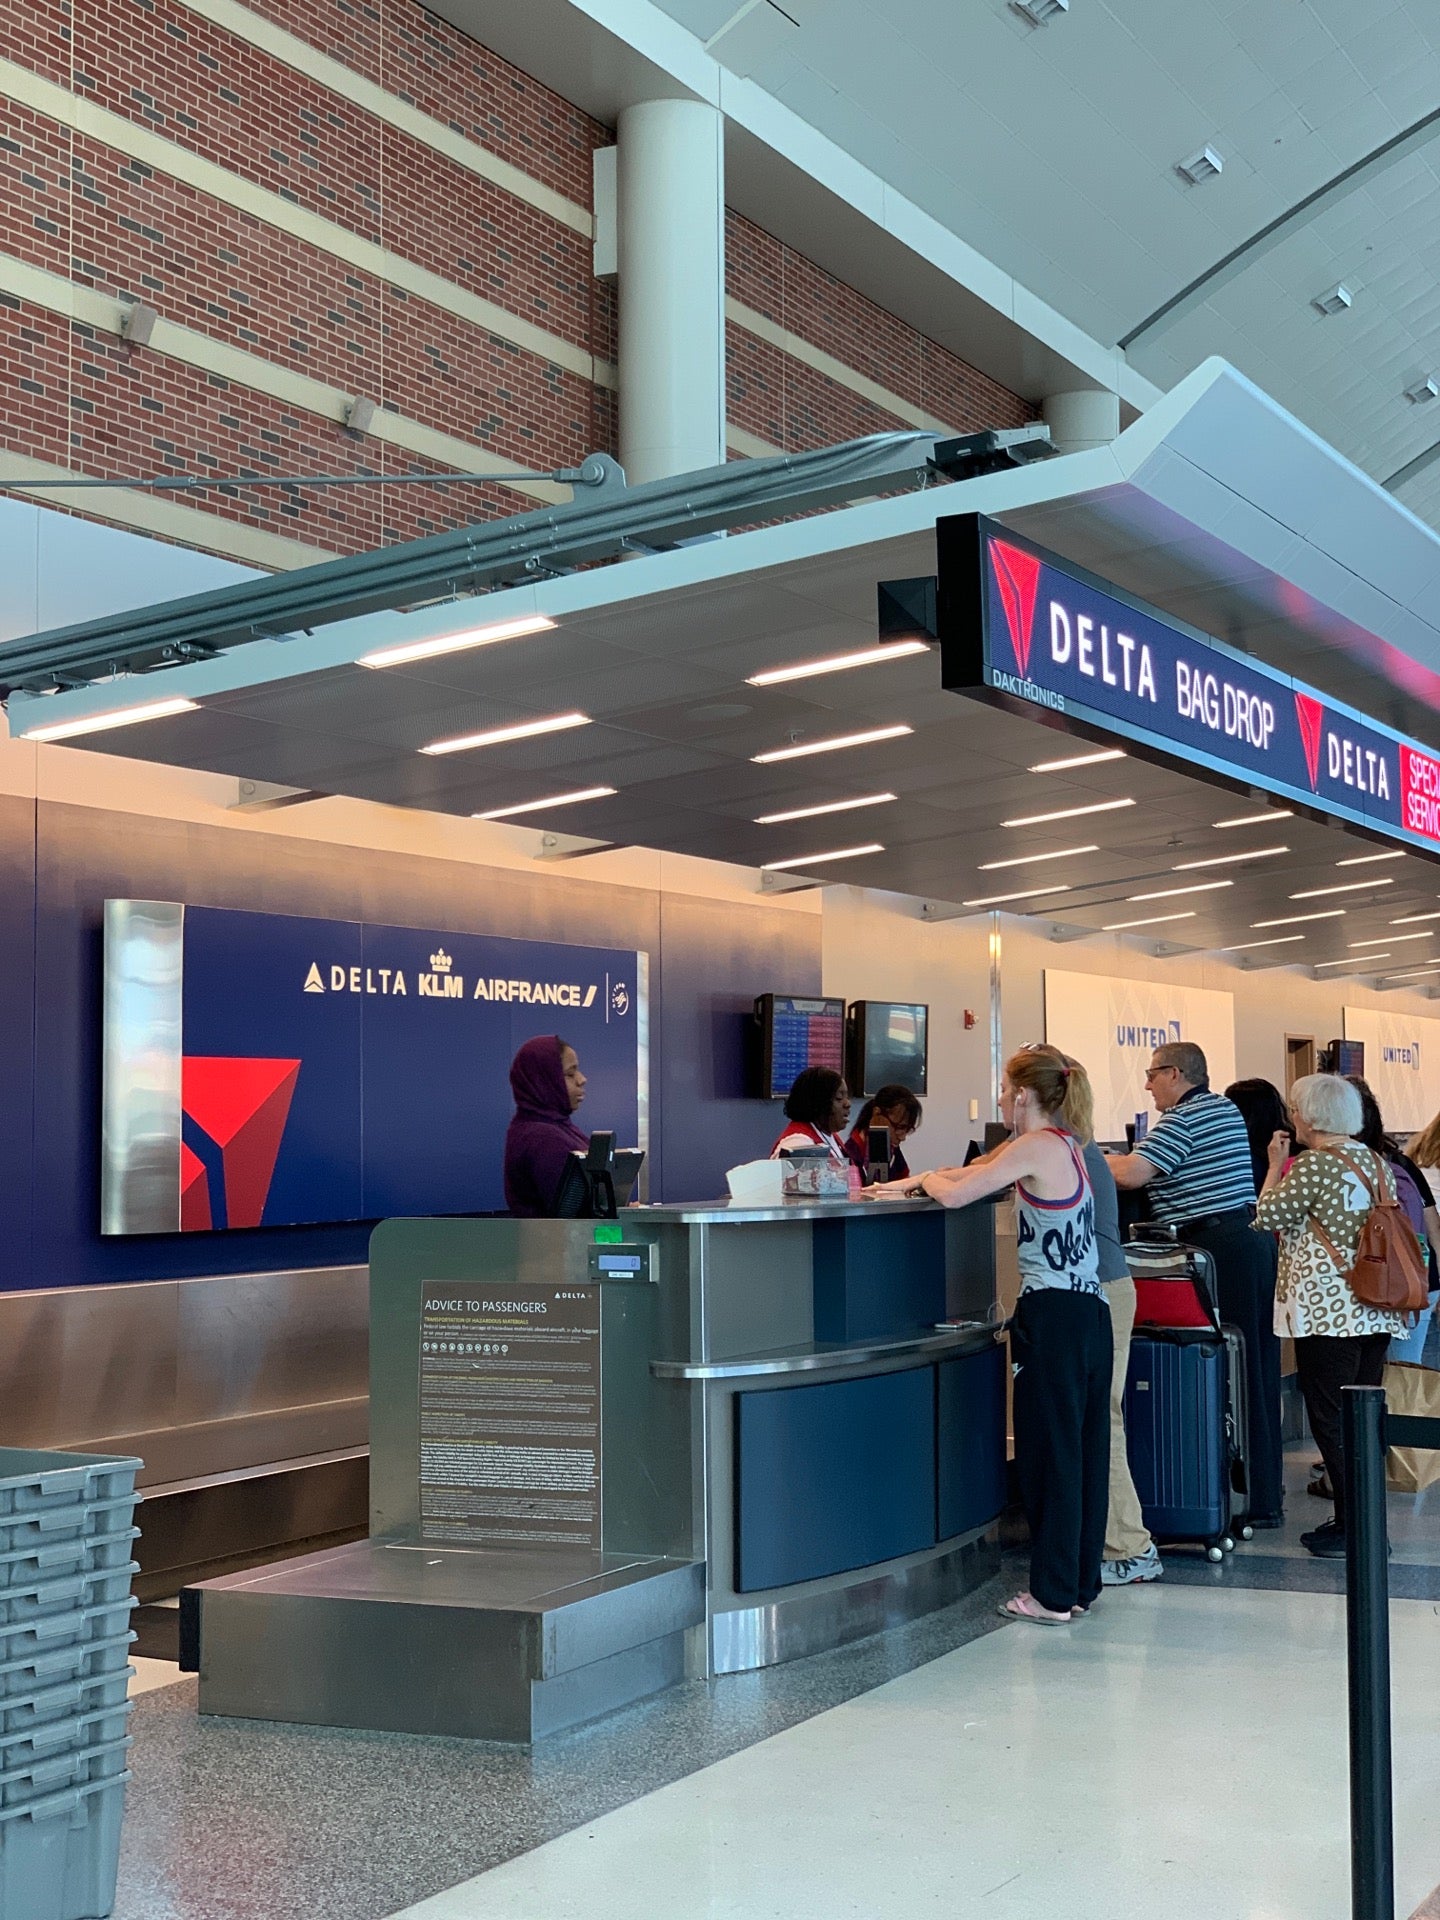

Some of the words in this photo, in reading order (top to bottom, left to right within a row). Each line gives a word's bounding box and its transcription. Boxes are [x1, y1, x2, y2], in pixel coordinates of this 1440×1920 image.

[993, 669, 1065, 711] DAKTRONICS
[1050, 601, 1157, 703] DELTA
[1176, 659, 1219, 730] BAG
[1224, 682, 1274, 750] DROP
[1328, 732, 1389, 801] DELTA
[1410, 753, 1440, 799] SPECI
[330, 965, 407, 995] DELTA
[418, 973, 463, 998] KLM
[473, 978, 581, 1007] AIRFRANCE
[1117, 1025, 1167, 1048] UNITED
[1383, 1047, 1412, 1064] UNITED
[425, 1300, 462, 1312] ADVICE
[466, 1301, 480, 1312] TO
[482, 1302, 547, 1313] PASSENGERS
